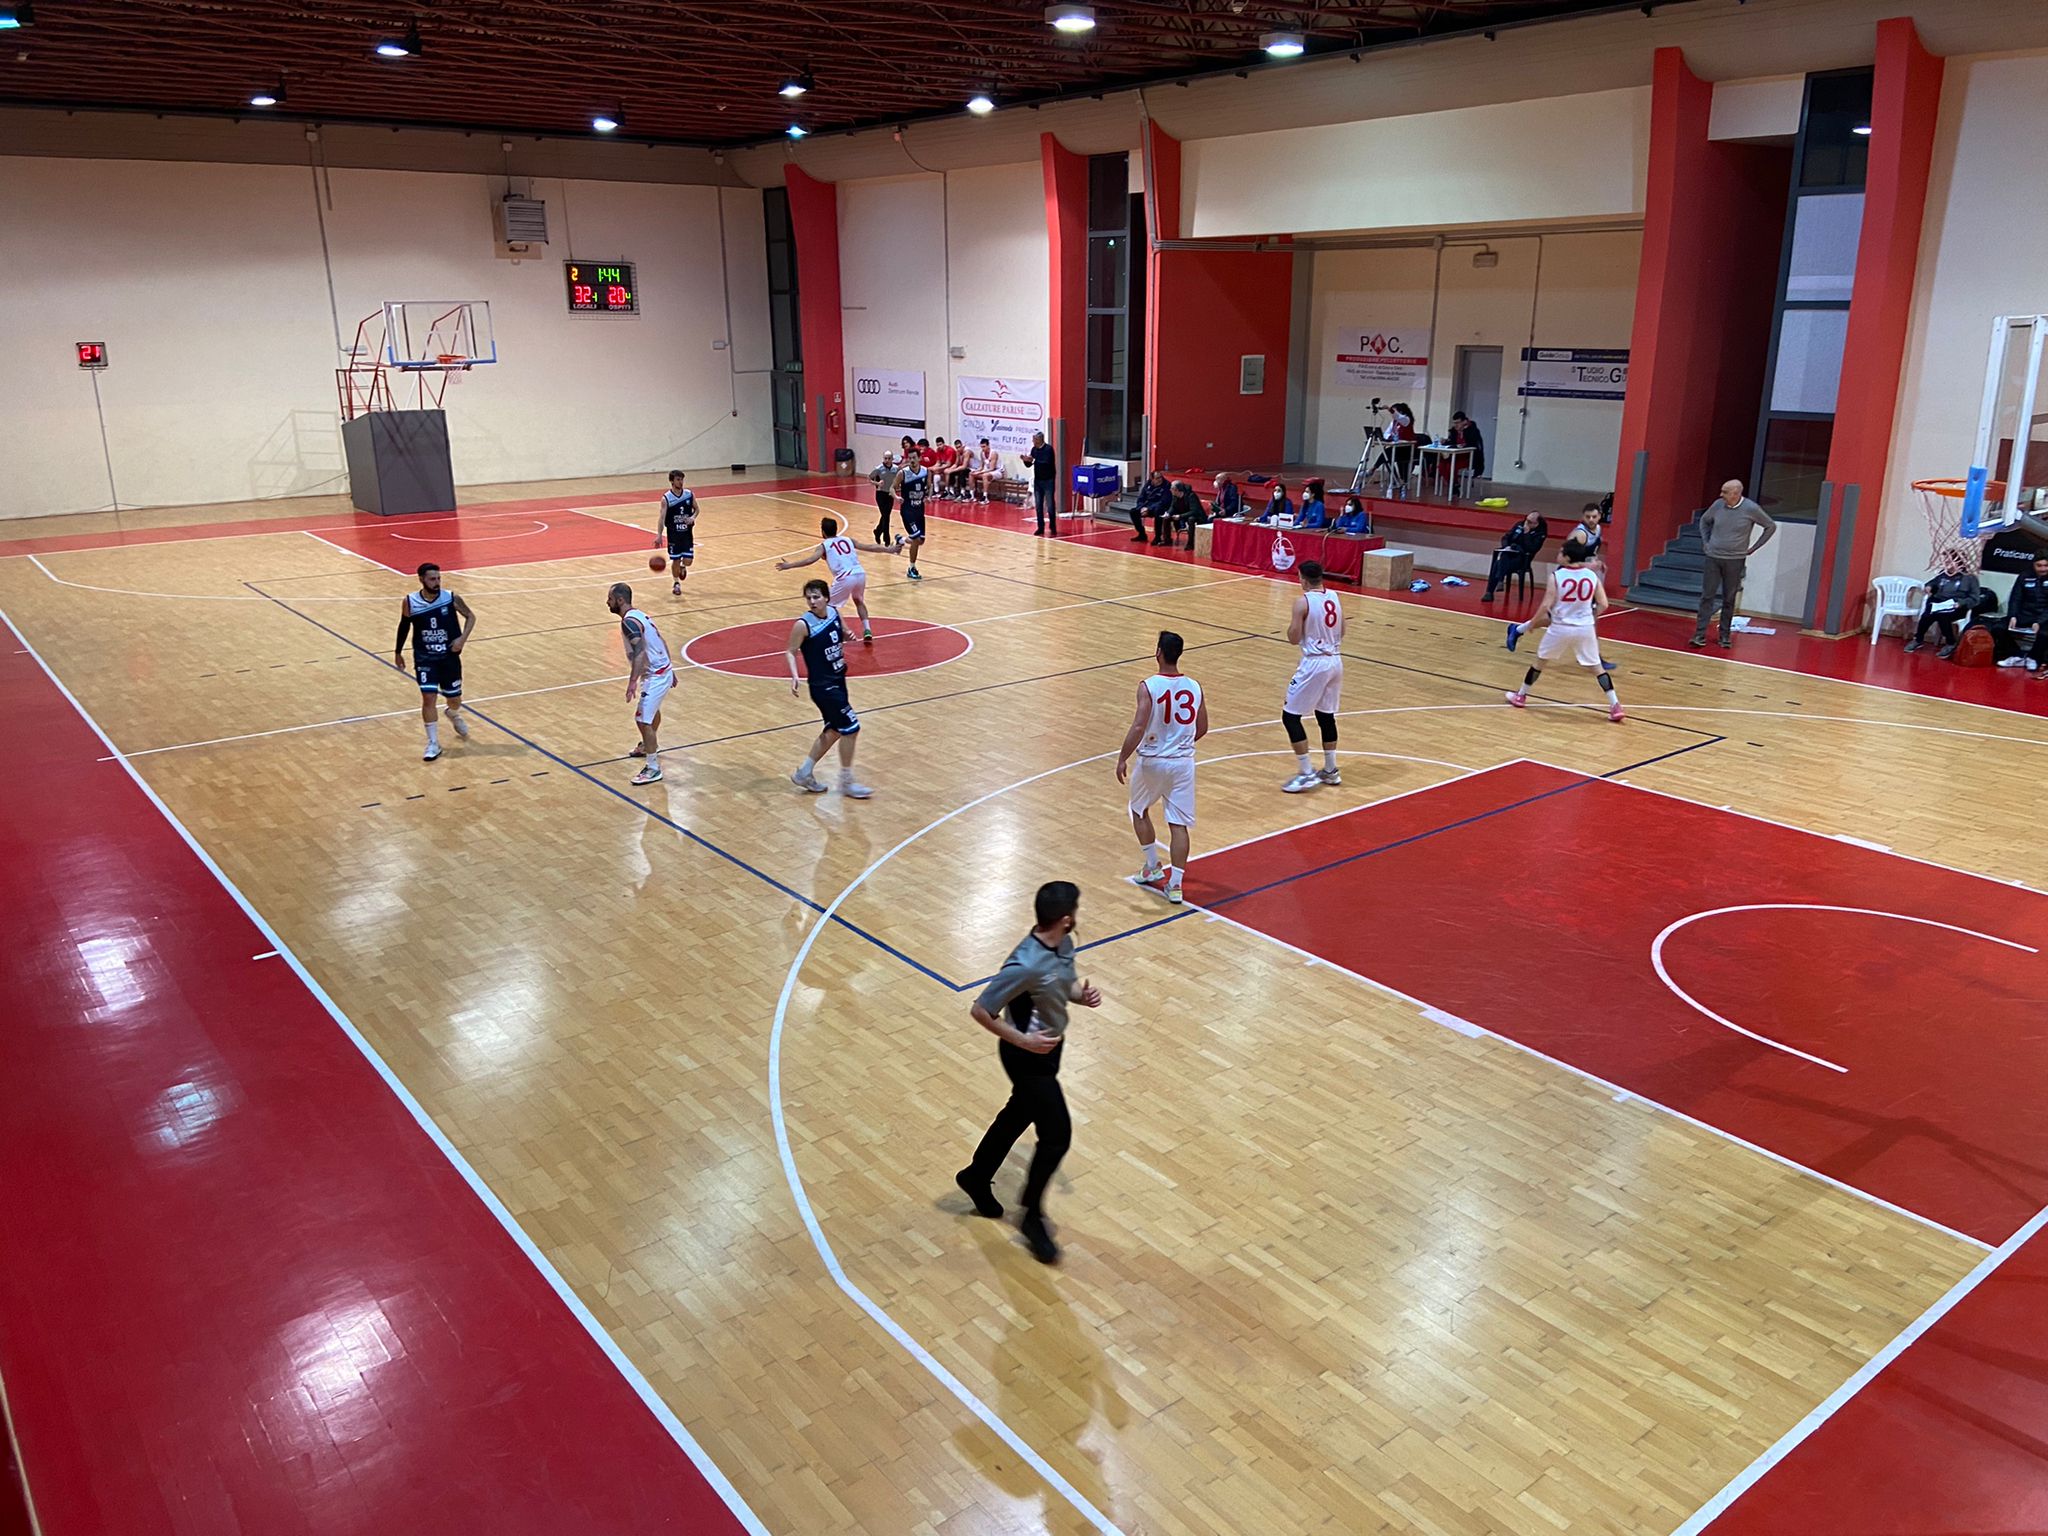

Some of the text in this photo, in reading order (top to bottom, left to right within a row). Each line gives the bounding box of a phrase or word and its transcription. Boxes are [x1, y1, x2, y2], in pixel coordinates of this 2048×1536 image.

[571, 267, 620, 282] 2 1:44
[575, 286, 591, 303] 32
[608, 287, 625, 304] 20
[81, 346, 100, 359] 21
[966, 402, 1000, 413] CALZATURE
[1002, 405, 1024, 415] PARISE
[830, 539, 851, 556] 10
[1993, 548, 2035, 560] Praticare
[1561, 578, 1594, 602] 20
[1324, 600, 1337, 628] 8
[1157, 689, 1196, 725] 13
